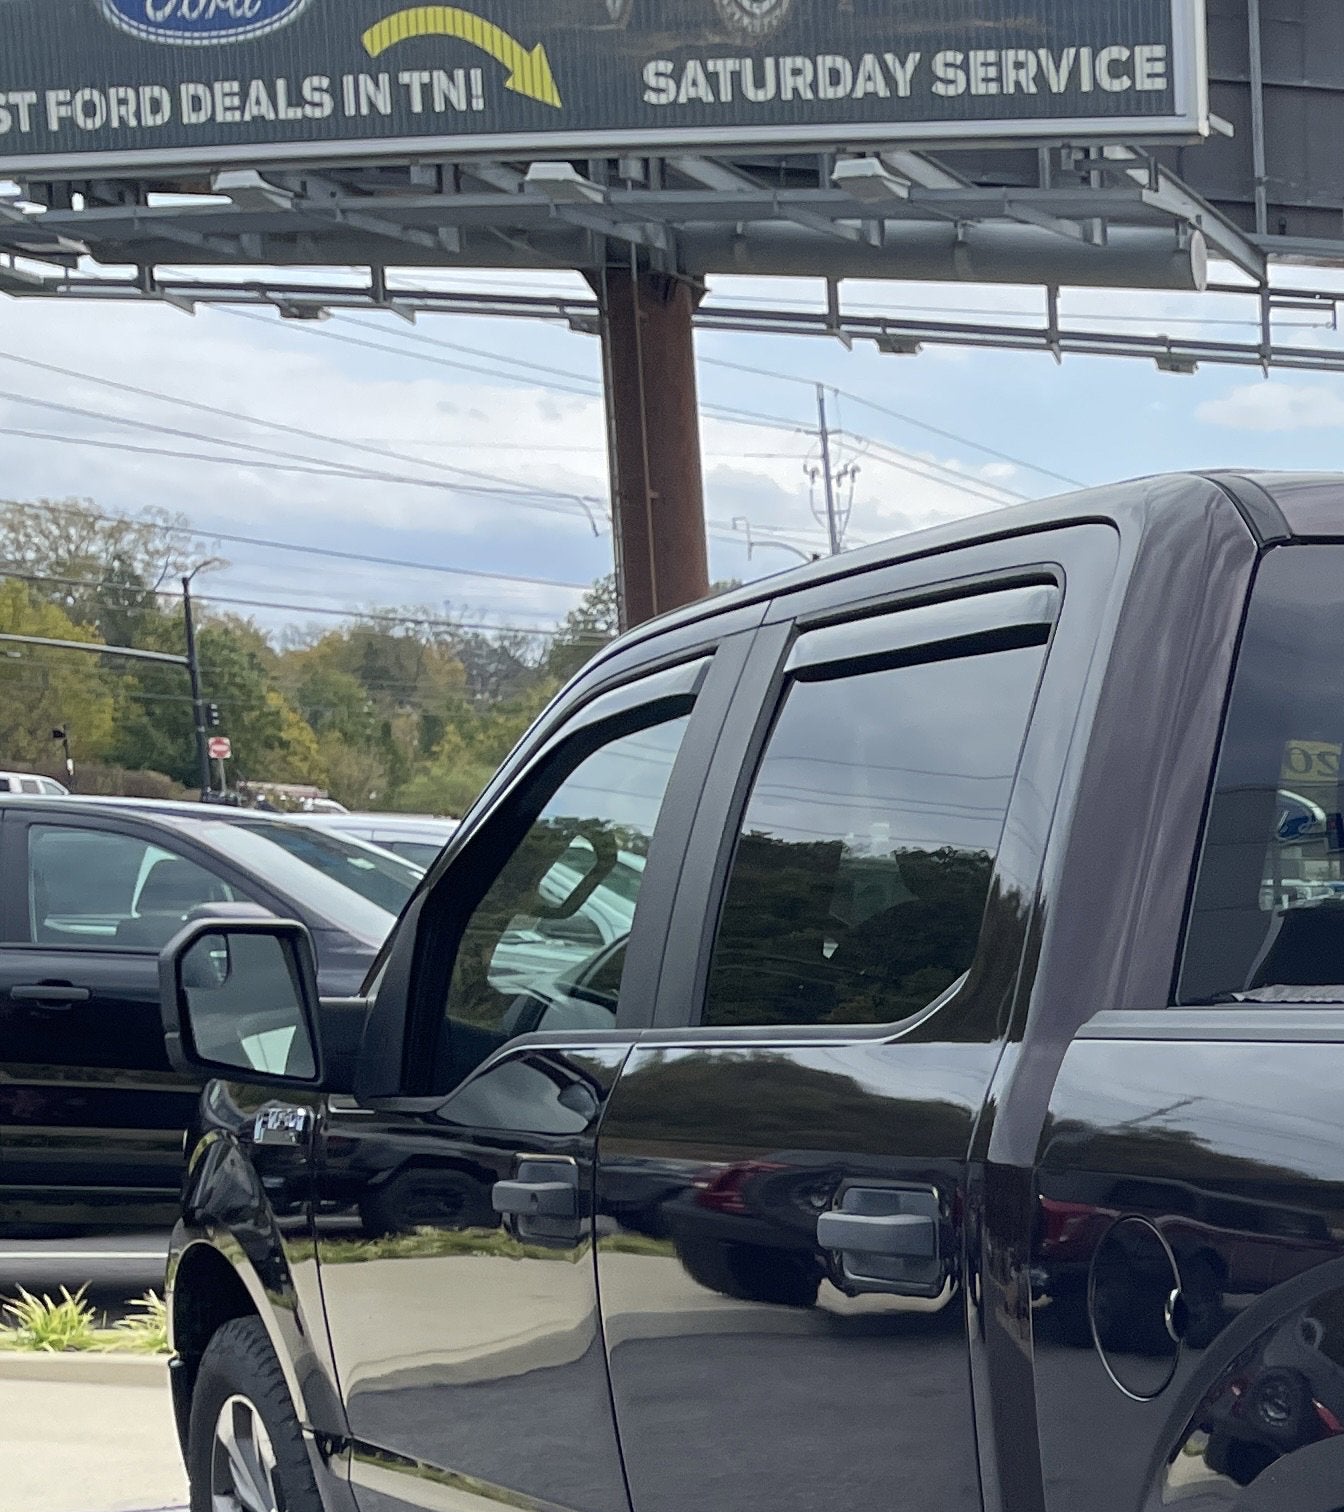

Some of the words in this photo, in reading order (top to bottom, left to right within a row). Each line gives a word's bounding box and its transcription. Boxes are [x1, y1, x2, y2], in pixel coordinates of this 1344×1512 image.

[46, 86, 172, 131] FORD
[180, 75, 334, 125] DEALS
[342, 72, 391, 117] IN
[398, 68, 485, 113] TN!
[641, 52, 921, 104] SATURDAY
[931, 44, 1167, 97] SERVICE
